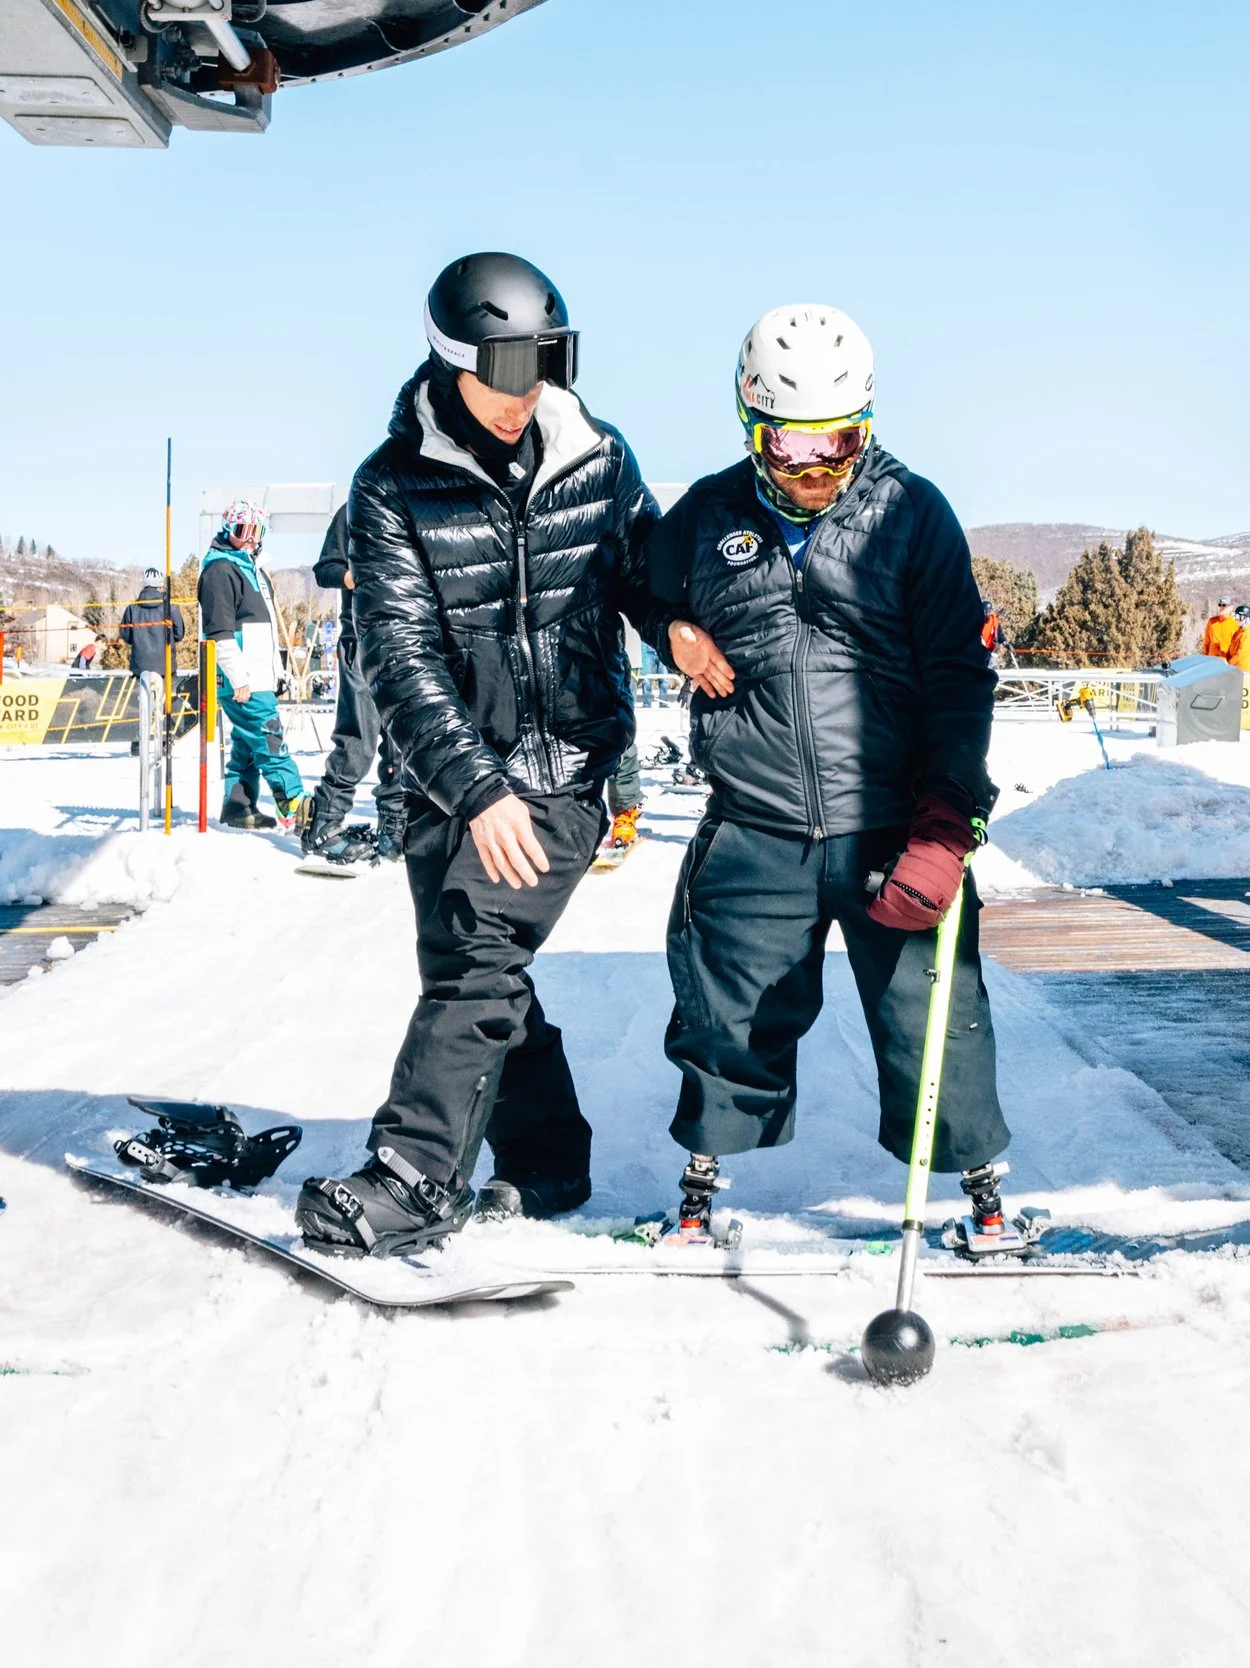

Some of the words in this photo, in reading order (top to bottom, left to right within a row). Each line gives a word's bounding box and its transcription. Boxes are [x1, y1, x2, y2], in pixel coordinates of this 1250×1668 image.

[726, 542, 753, 556] CAF
[0, 695, 39, 707] OOD
[1, 710, 39, 721] ARD
